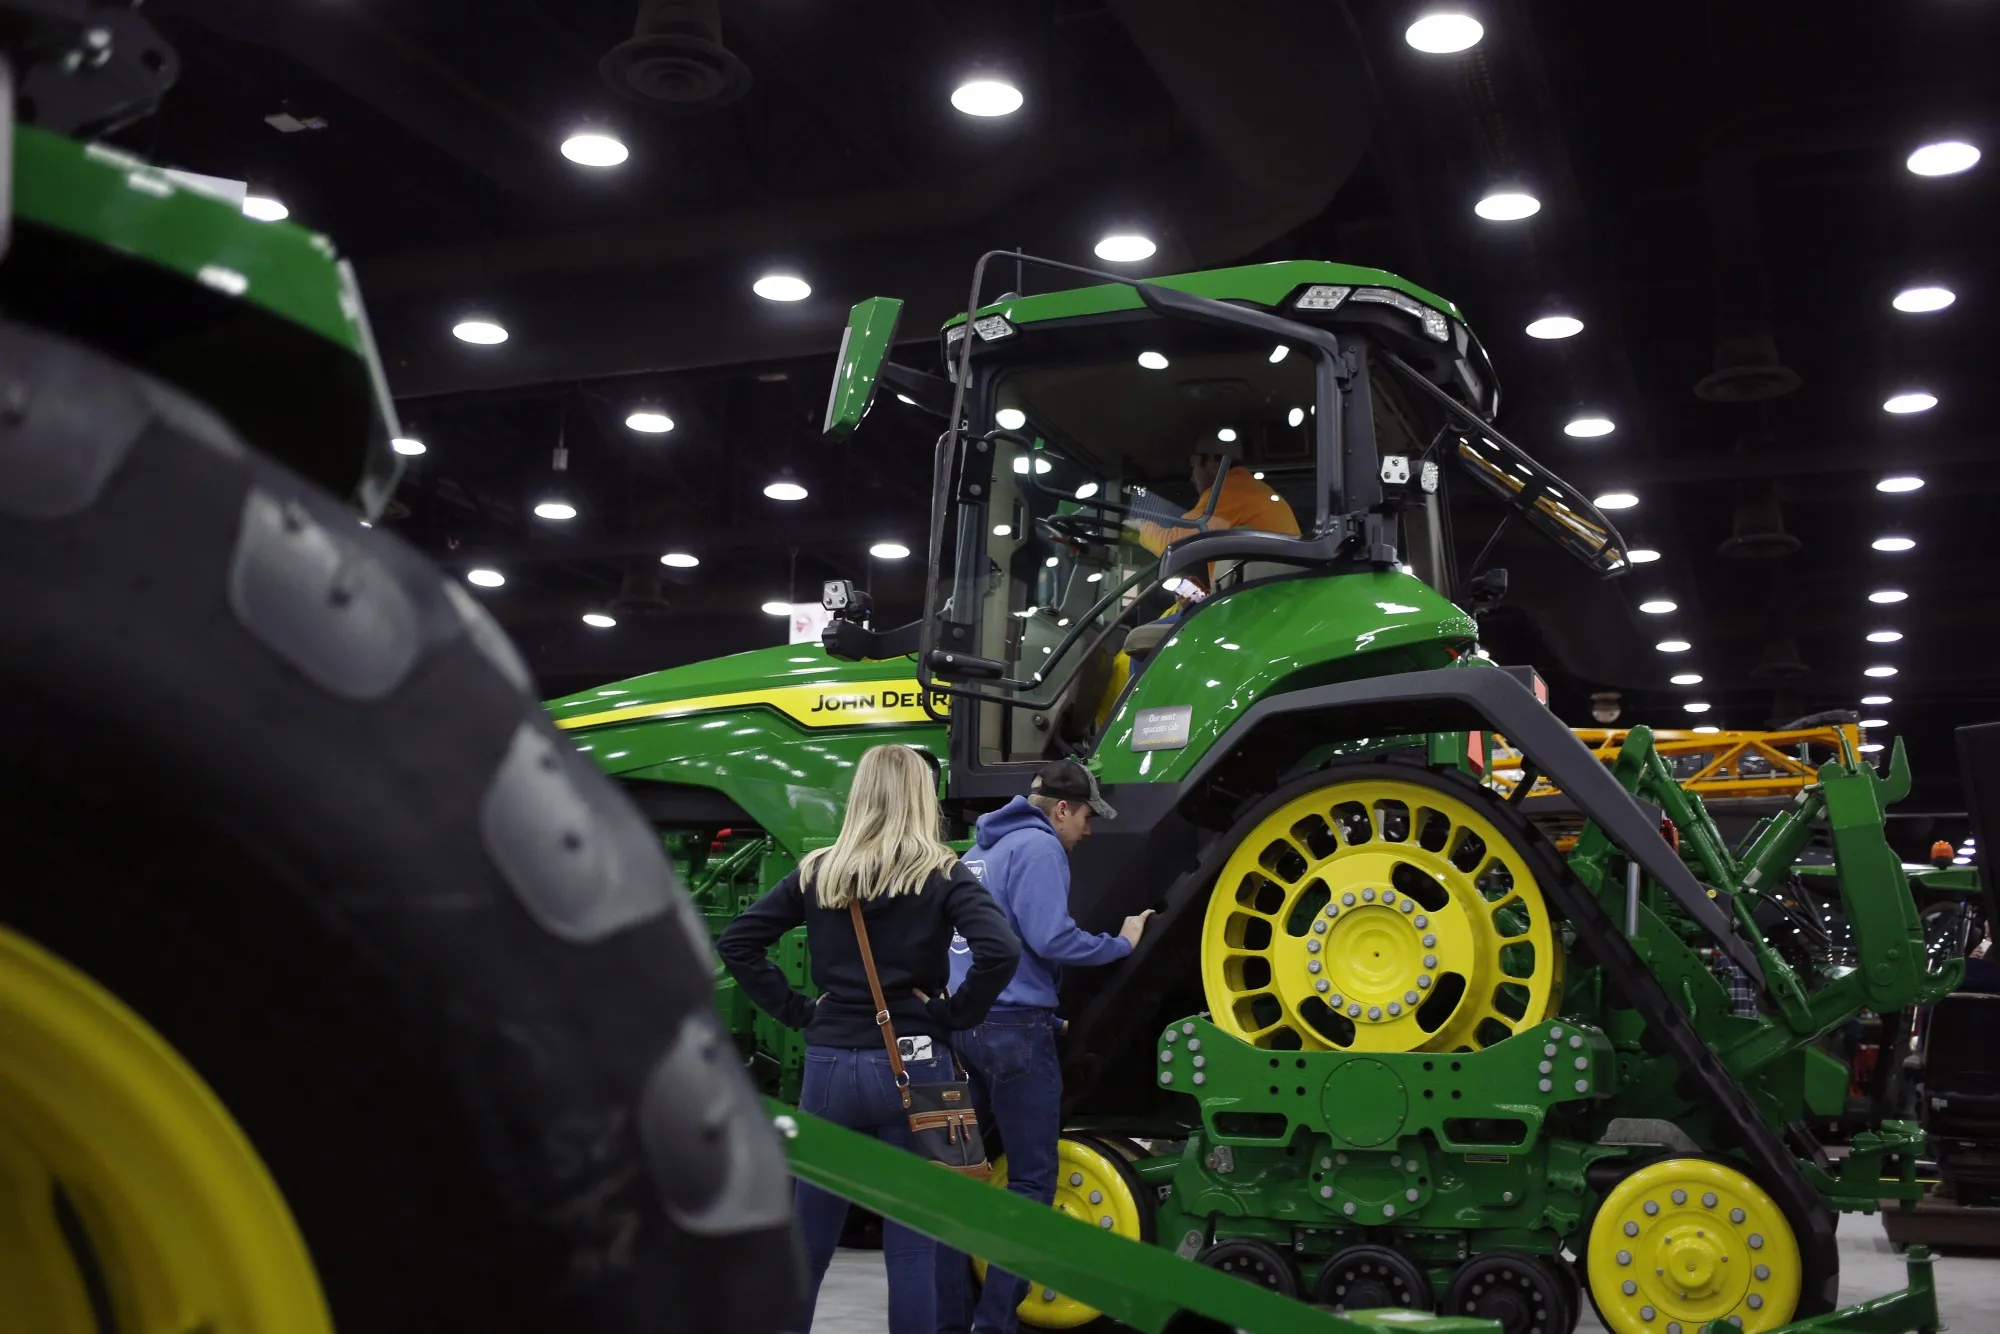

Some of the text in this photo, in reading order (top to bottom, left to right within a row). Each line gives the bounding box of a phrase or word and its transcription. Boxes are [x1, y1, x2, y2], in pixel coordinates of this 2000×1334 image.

[811, 691, 951, 712] JOHN DEER
[1149, 713, 1176, 722] Our most
[1143, 722, 1178, 735] spacious cab
